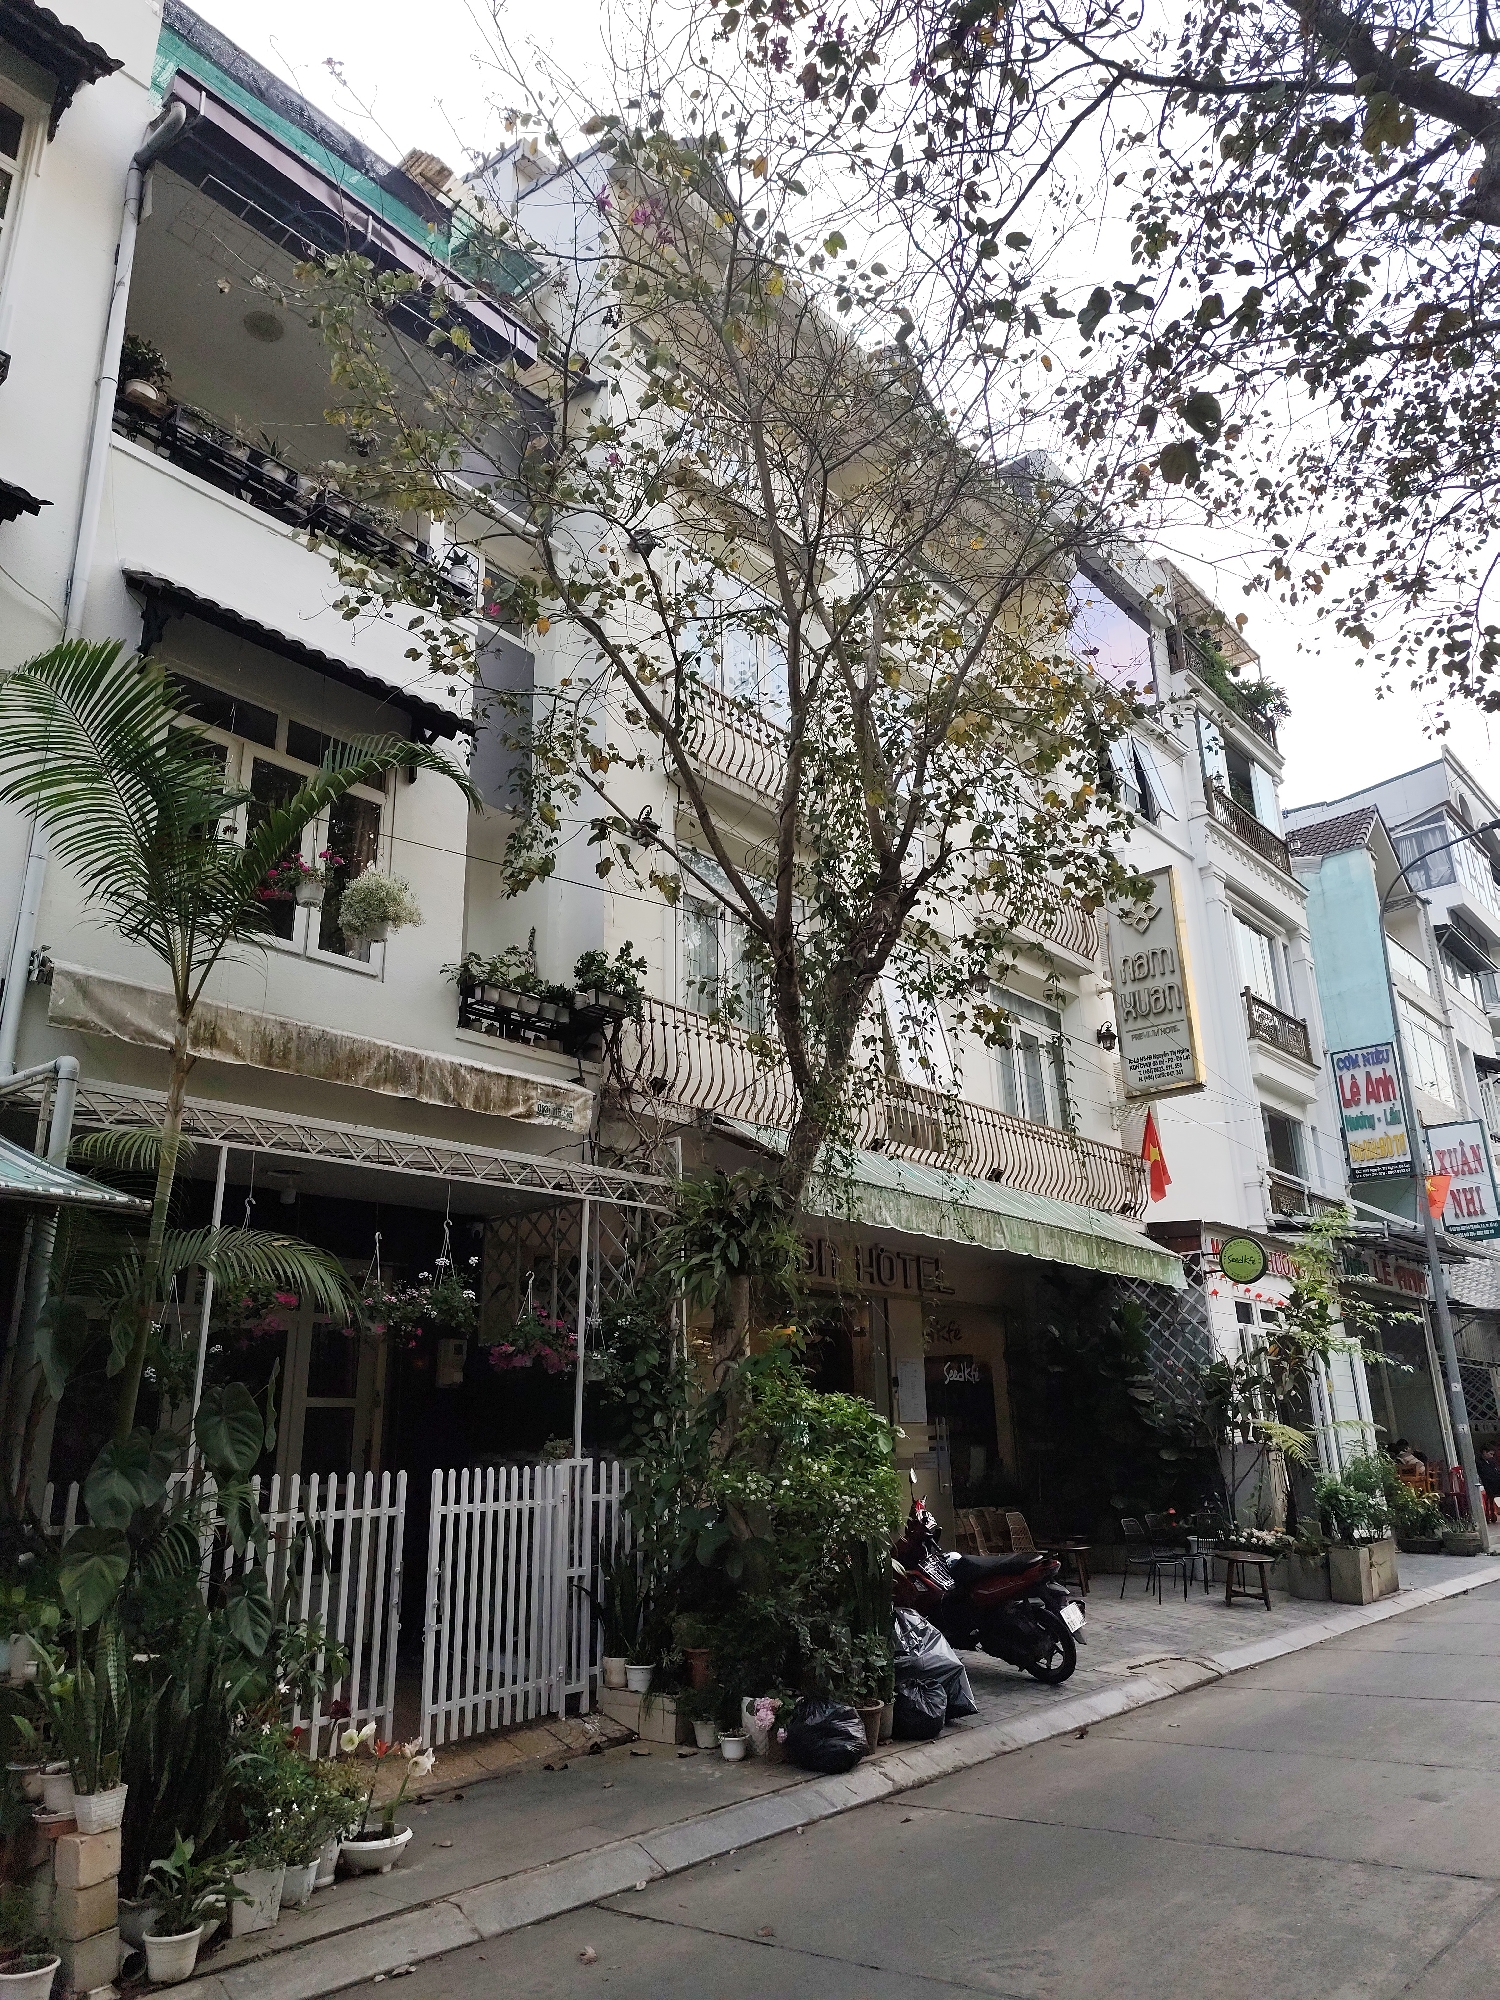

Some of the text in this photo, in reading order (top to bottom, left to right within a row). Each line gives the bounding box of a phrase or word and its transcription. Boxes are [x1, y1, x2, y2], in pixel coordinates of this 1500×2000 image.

[1120, 946, 1176, 984] nam
[1131, 1024, 1181, 1042] PREMIUM HOTEL
[1338, 1068, 1398, 1109] Lê Anh
[1434, 1139, 1485, 1177] XUÂN
[1449, 1185, 1487, 1220] NHI
[855, 1242, 956, 1296] HOTEL
